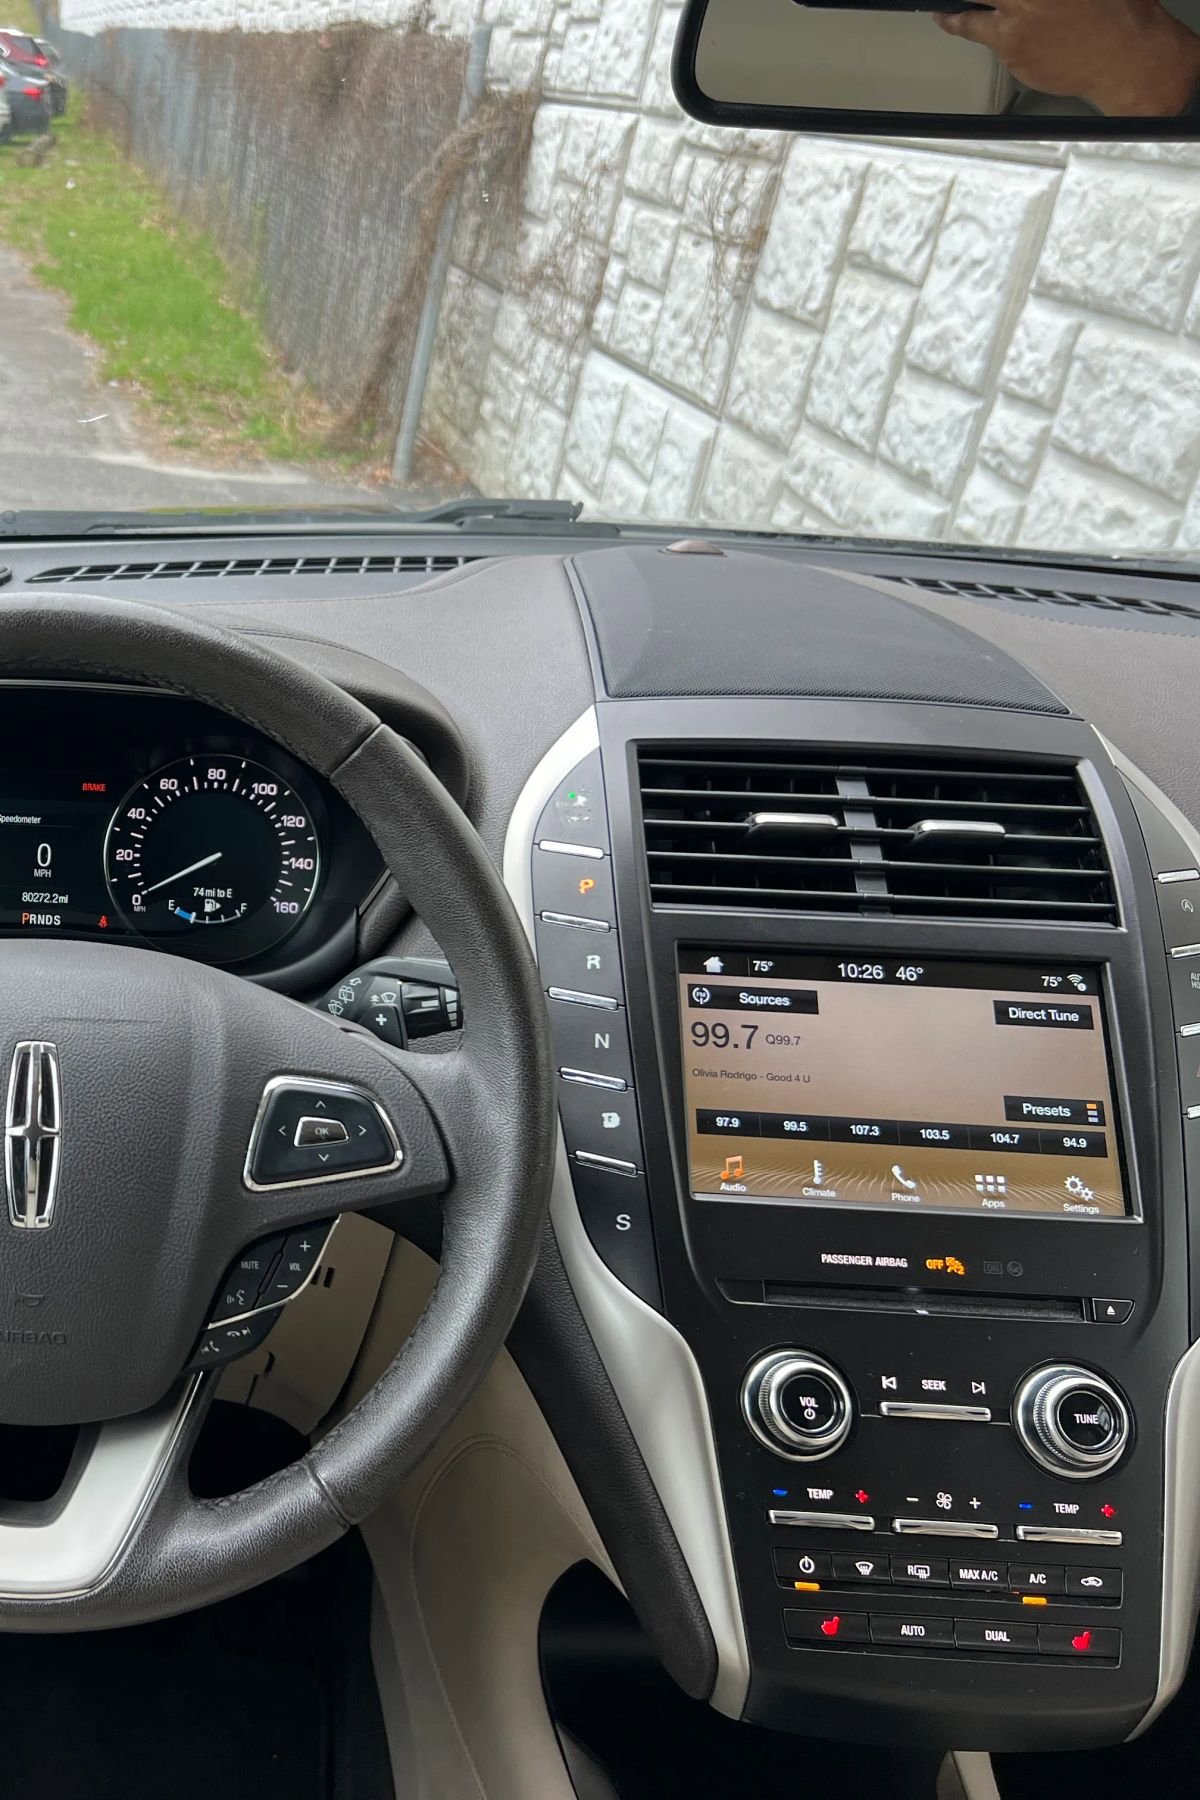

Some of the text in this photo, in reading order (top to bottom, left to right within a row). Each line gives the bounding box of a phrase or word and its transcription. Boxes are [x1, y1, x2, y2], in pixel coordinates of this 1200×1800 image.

[208, 768, 226, 780] 80
[82, 782, 106, 792] BRAKE
[160, 778, 178, 790] 60
[252, 784, 278, 796] 100
[127, 808, 145, 820] 40
[280, 816, 305, 828] 120
[37, 843, 52, 867] 0
[116, 850, 133, 860] 20
[290, 858, 314, 870] 140
[34, 868, 52, 878] MPH
[580, 879, 595, 894] P
[193, 888, 204, 896] 74
[217, 888, 226, 898] to
[227, 888, 232, 898] E
[132, 894, 142, 906] 0
[168, 900, 175, 910] E
[240, 903, 248, 914] F
[274, 902, 298, 914] 160
[586, 955, 600, 970] R
[752, 960, 773, 972] 75°
[838, 963, 924, 982] 10:26 46°
[1041, 976, 1062, 988] 75°
[739, 992, 790, 1006] Sources
[1008, 1007, 1080, 1022] Direct Tune
[594, 1032, 610, 1048] N
[691, 1022, 800, 1049] 99.7 Q99.7
[692, 1068, 718, 1078] Olivia
[720, 1070, 758, 1082] Rodrigo
[766, 1072, 792, 1082] Good
[794, 1074, 800, 1082] 4
[803, 1074, 810, 1083] U
[1022, 1103, 1071, 1117] Presets
[716, 1116, 1086, 1148] 97.9 99.5 107.3 103.5 104.7 94.9
[720, 1182, 1100, 1214] Audio Climate Phone Apps Settings
[616, 1214, 632, 1232] S
[240, 1260, 260, 1270] MUTE
[289, 1263, 302, 1271] VOL
[821, 1254, 908, 1268] PASSENGER AIRBAG
[926, 1260, 944, 1270] OFF
[922, 1378, 946, 1392] SEEK
[800, 1396, 819, 1408] VOL
[1074, 1414, 1098, 1425] TUNE
[806, 1487, 834, 1500] TEMP
[1054, 1502, 1080, 1514] TEMP
[959, 1568, 998, 1581] MAX A/C
[1029, 1574, 1047, 1584] A/C
[900, 1624, 926, 1636] AUTO
[985, 1630, 1011, 1642] DUAL
